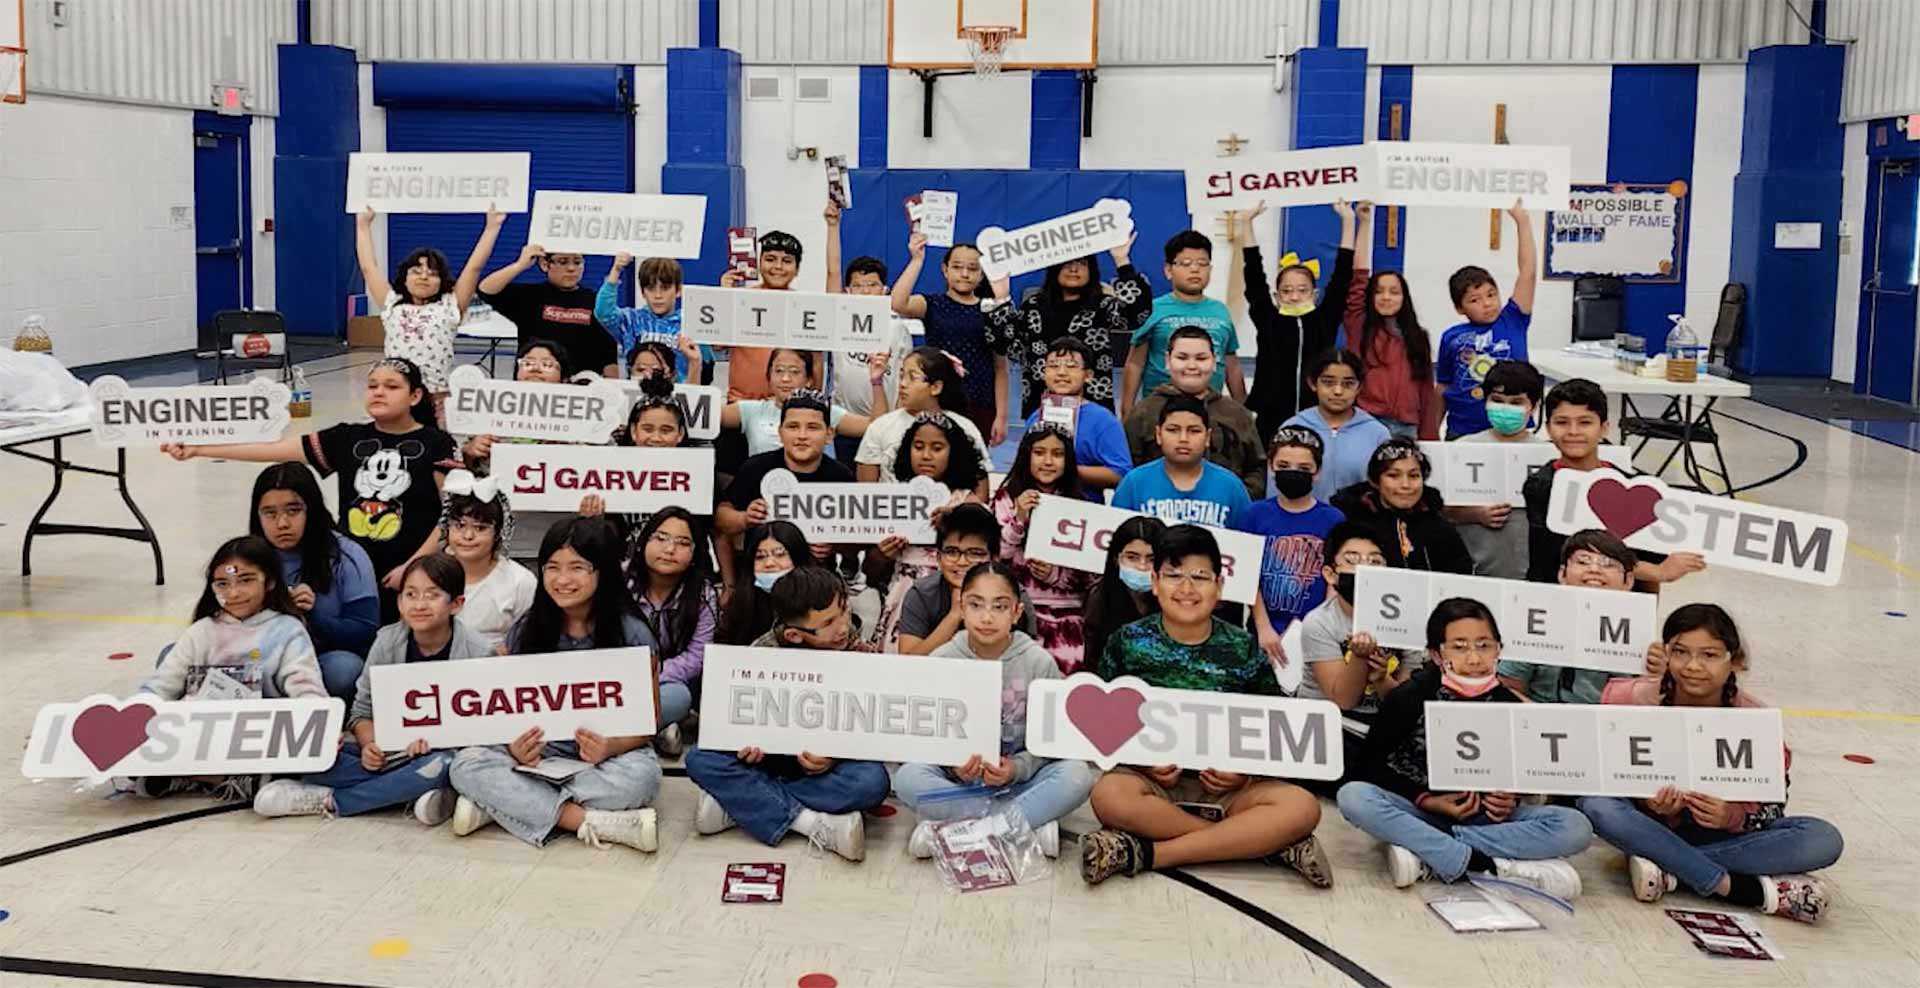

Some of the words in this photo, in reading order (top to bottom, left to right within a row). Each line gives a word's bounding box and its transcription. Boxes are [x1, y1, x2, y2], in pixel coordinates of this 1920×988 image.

[366, 175, 510, 199] ENGINEER
[1240, 166, 1358, 191] GARVER
[1386, 165, 1549, 195] ENGINEER
[1569, 199, 1664, 213] MPOSSIBLE
[546, 214, 684, 243] ENGINEER
[1556, 213, 1598, 226] WALL
[1602, 214, 1624, 227] OF
[1629, 215, 1671, 228] FAME
[989, 212, 1117, 263] ENGINEER
[102, 396, 270, 425] ENGINEER
[457, 387, 605, 422] ENGINEER
[146, 429, 159, 438] IN
[168, 427, 236, 437] TRAINING
[511, 420, 570, 432] TRAINING
[554, 467, 691, 492] GARVER
[773, 493, 929, 521] ENGINEER
[811, 526, 824, 534] IN
[831, 525, 896, 535] TRAINING
[1561, 480, 1580, 525] I
[1651, 499, 1833, 573] STEM
[731, 668, 752, 679] I'M
[757, 670, 766, 680] A
[772, 672, 824, 684] FUTURE
[450, 680, 624, 717] GARVER
[728, 684, 968, 740] ENGINEER
[39, 713, 69, 765] I
[137, 708, 330, 763] STEM
[1041, 690, 1056, 743] I
[1138, 699, 1328, 766] STEM
[1613, 773, 1677, 782] ENGINEERING
[1700, 775, 1770, 784] MATHEMATICS
